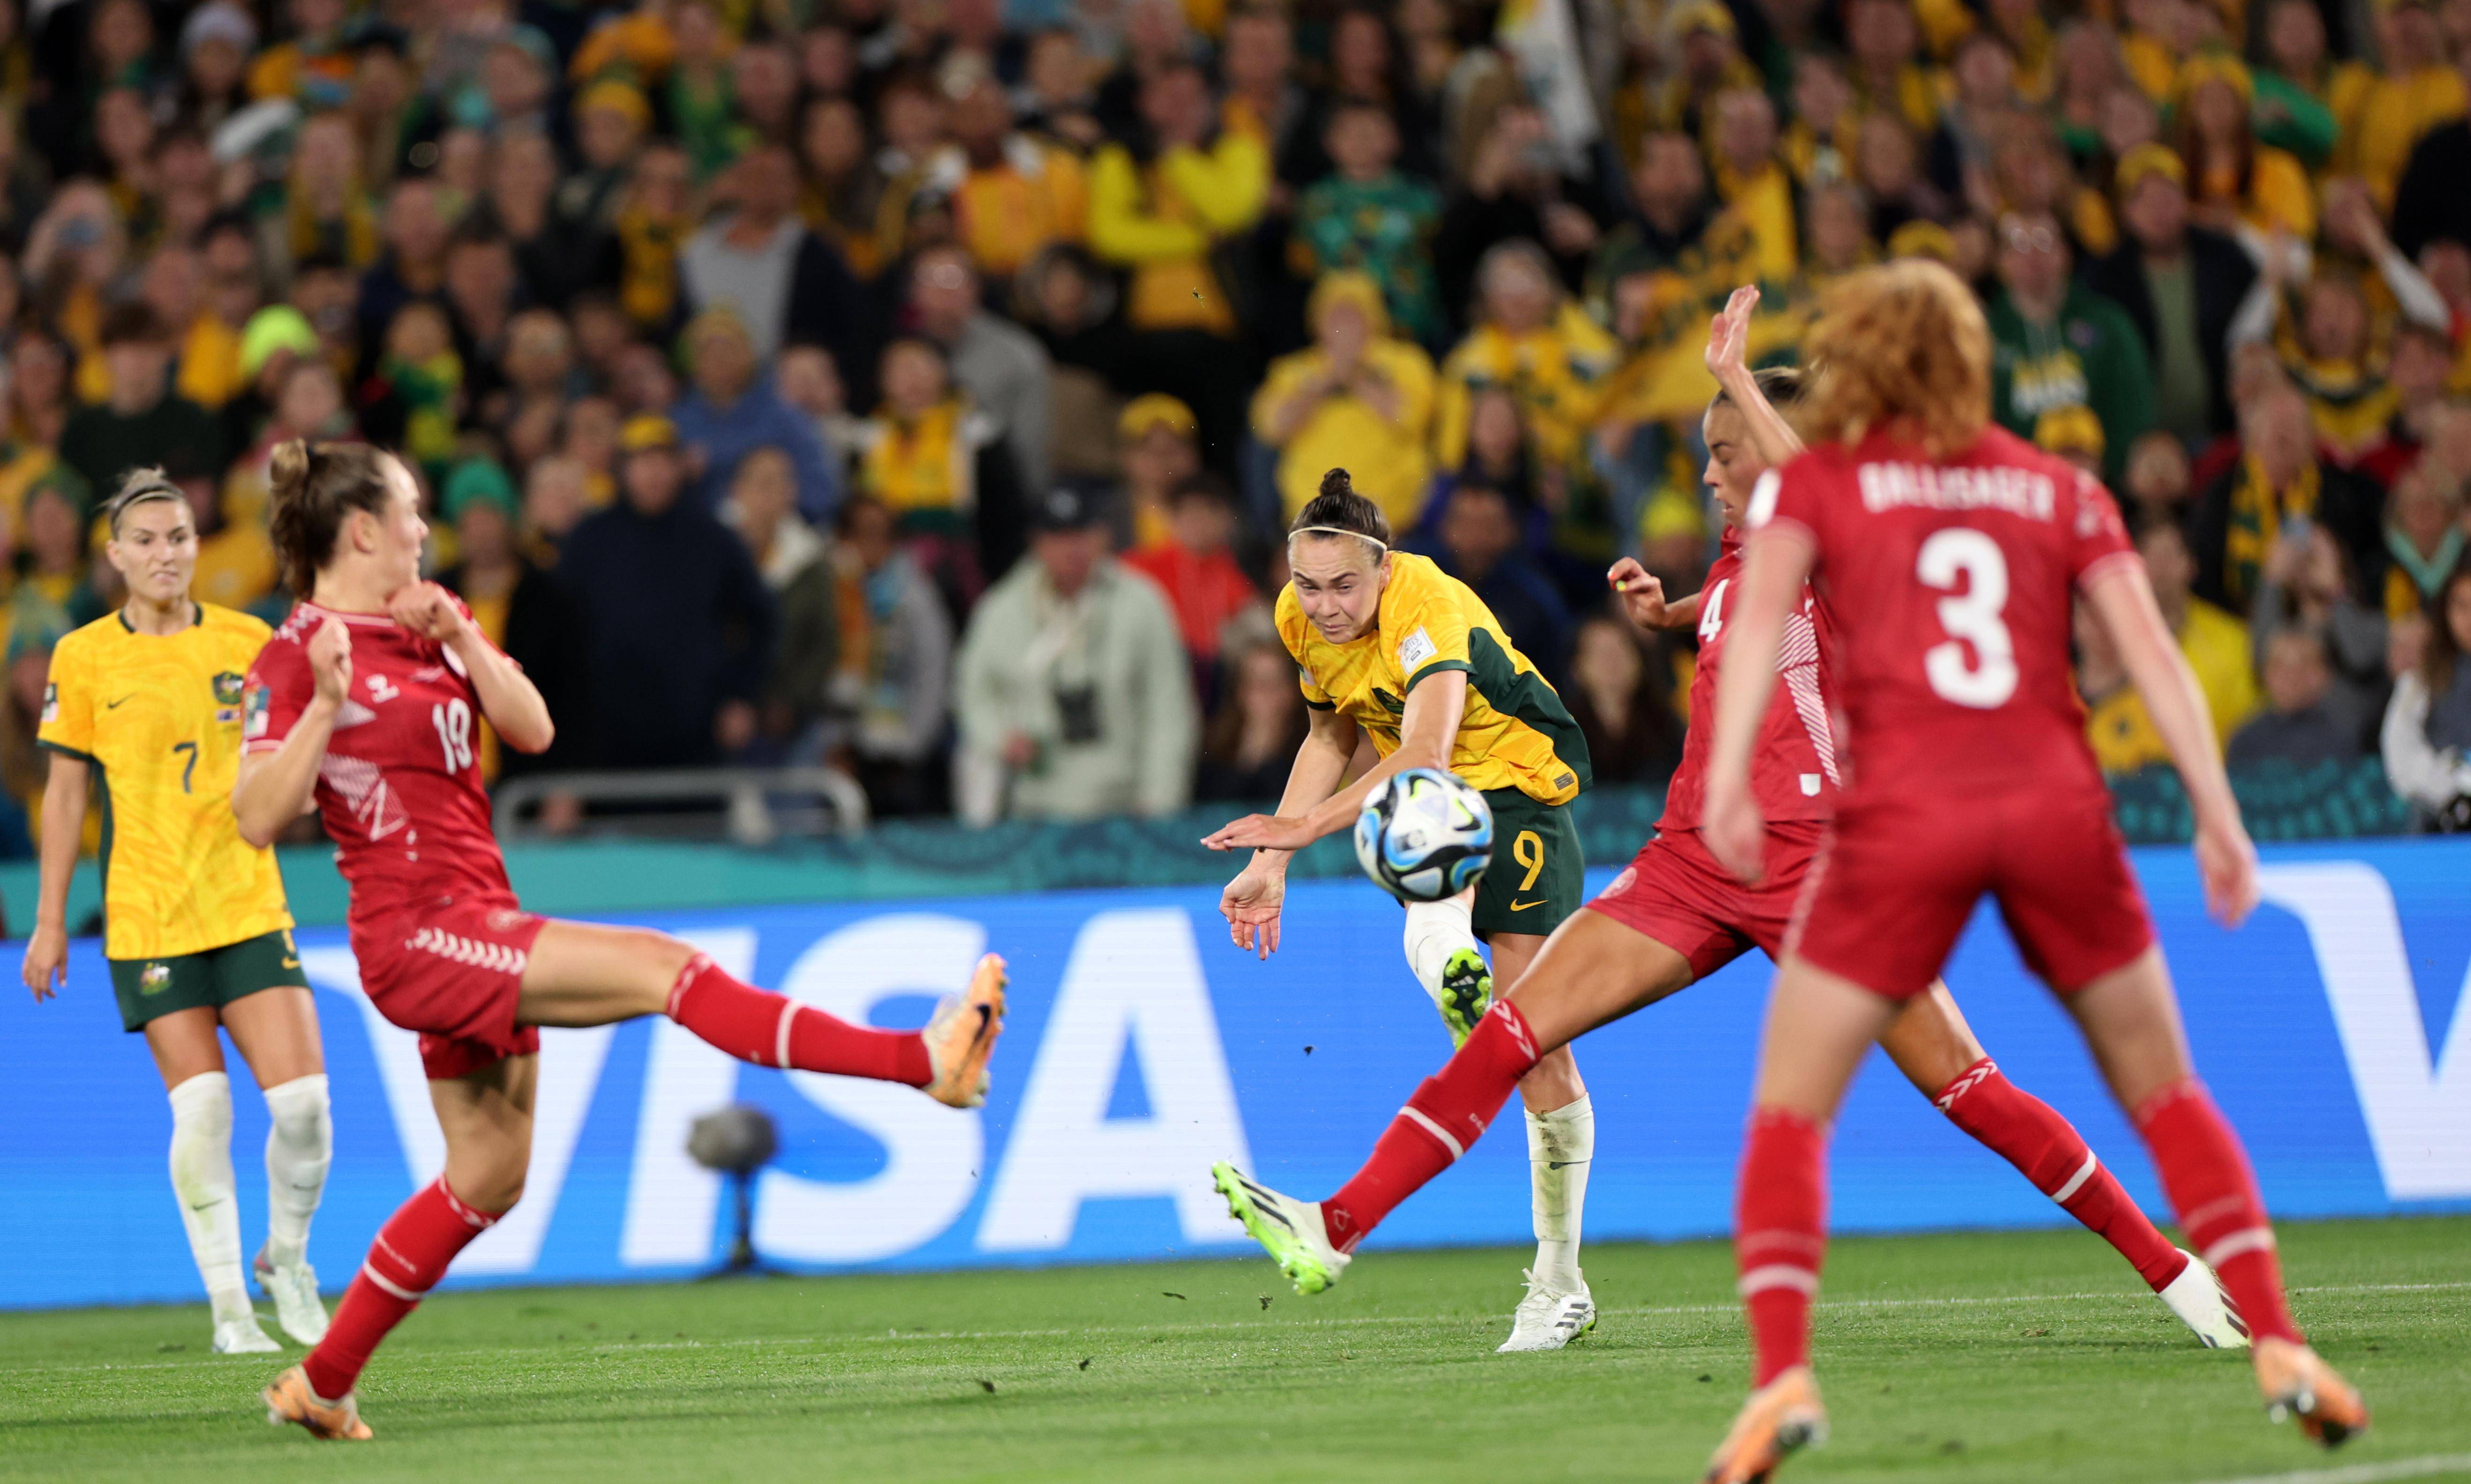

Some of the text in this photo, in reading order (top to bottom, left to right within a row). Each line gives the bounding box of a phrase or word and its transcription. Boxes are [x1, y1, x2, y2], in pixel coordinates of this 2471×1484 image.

[1699, 579, 1730, 642] 4
[1917, 527, 2019, 710] 3
[174, 741, 199, 794] 7
[432, 697, 473, 775] 19
[1513, 830, 1544, 891] 9
[300, 907, 1257, 1275] VISA
